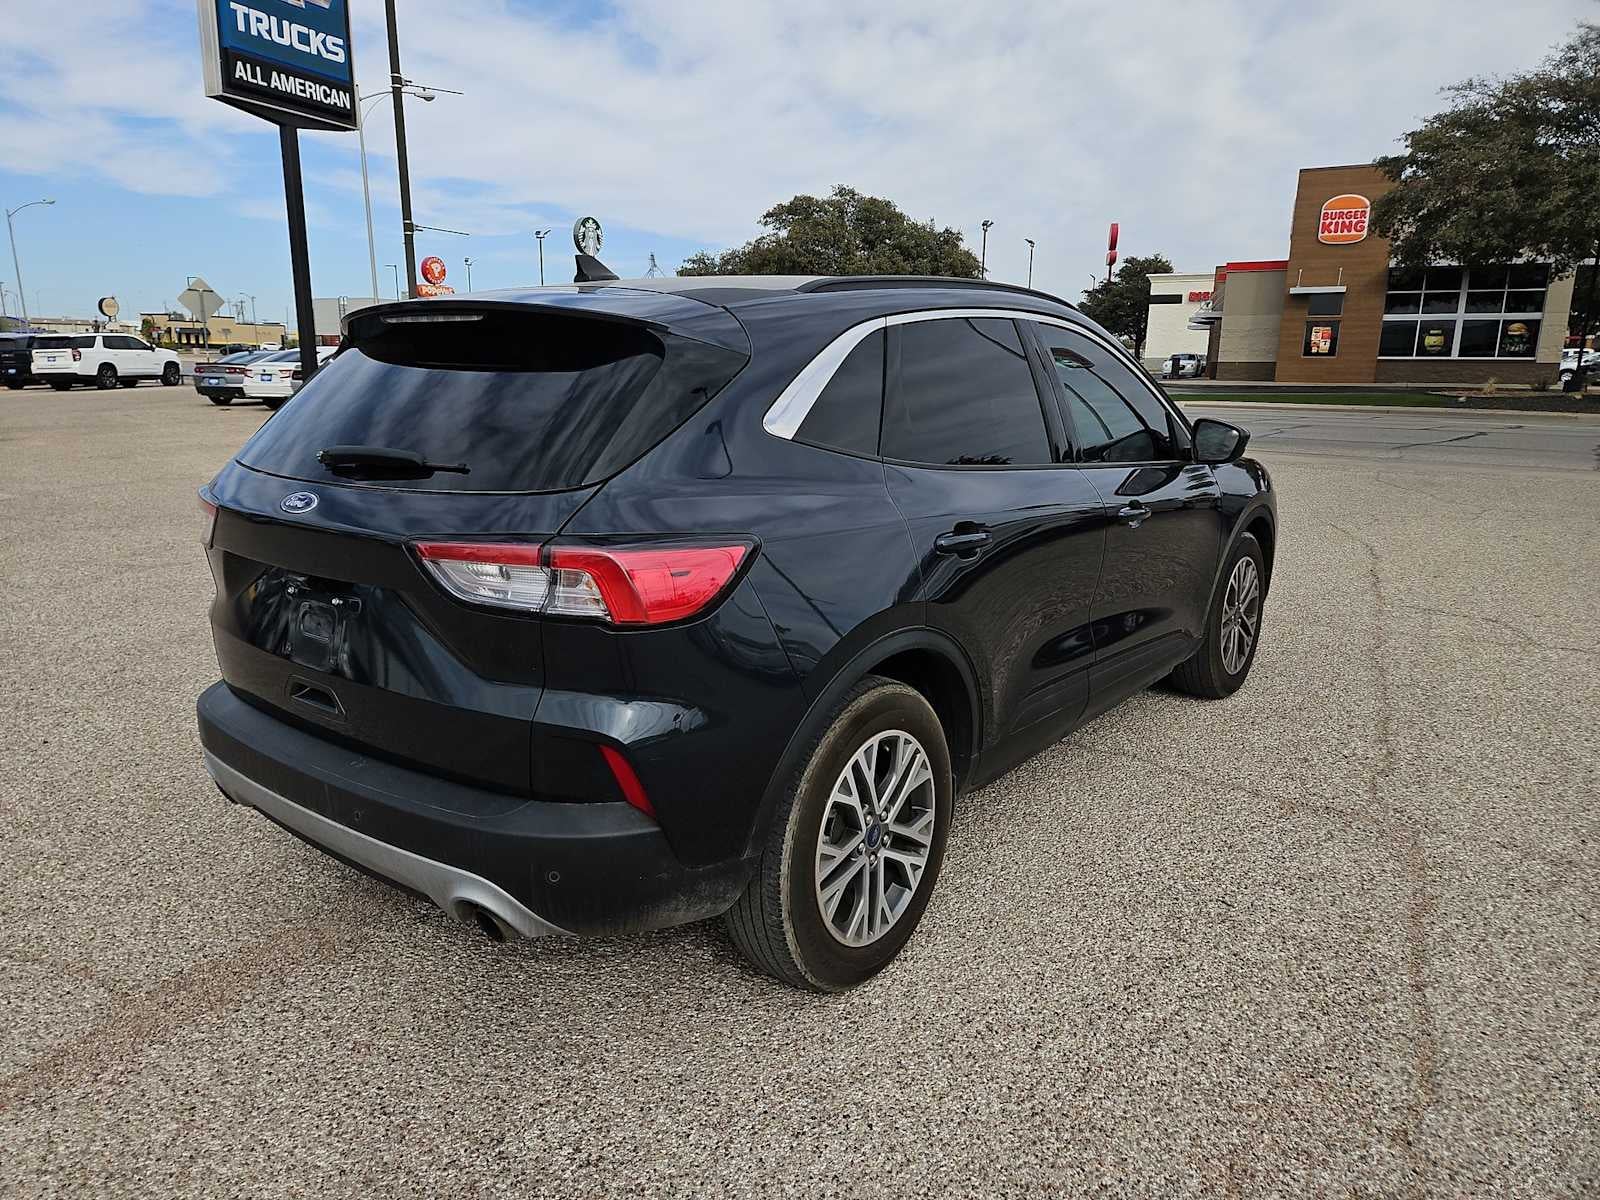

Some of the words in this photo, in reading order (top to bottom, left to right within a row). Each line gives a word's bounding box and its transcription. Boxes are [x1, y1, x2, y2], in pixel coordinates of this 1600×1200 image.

[229, 1, 346, 64] TRUCKS
[235, 60, 268, 87] ALL
[270, 70, 351, 110] AMERICAN
[1321, 220, 1366, 234] KING
[1322, 209, 1367, 221] BURGER
